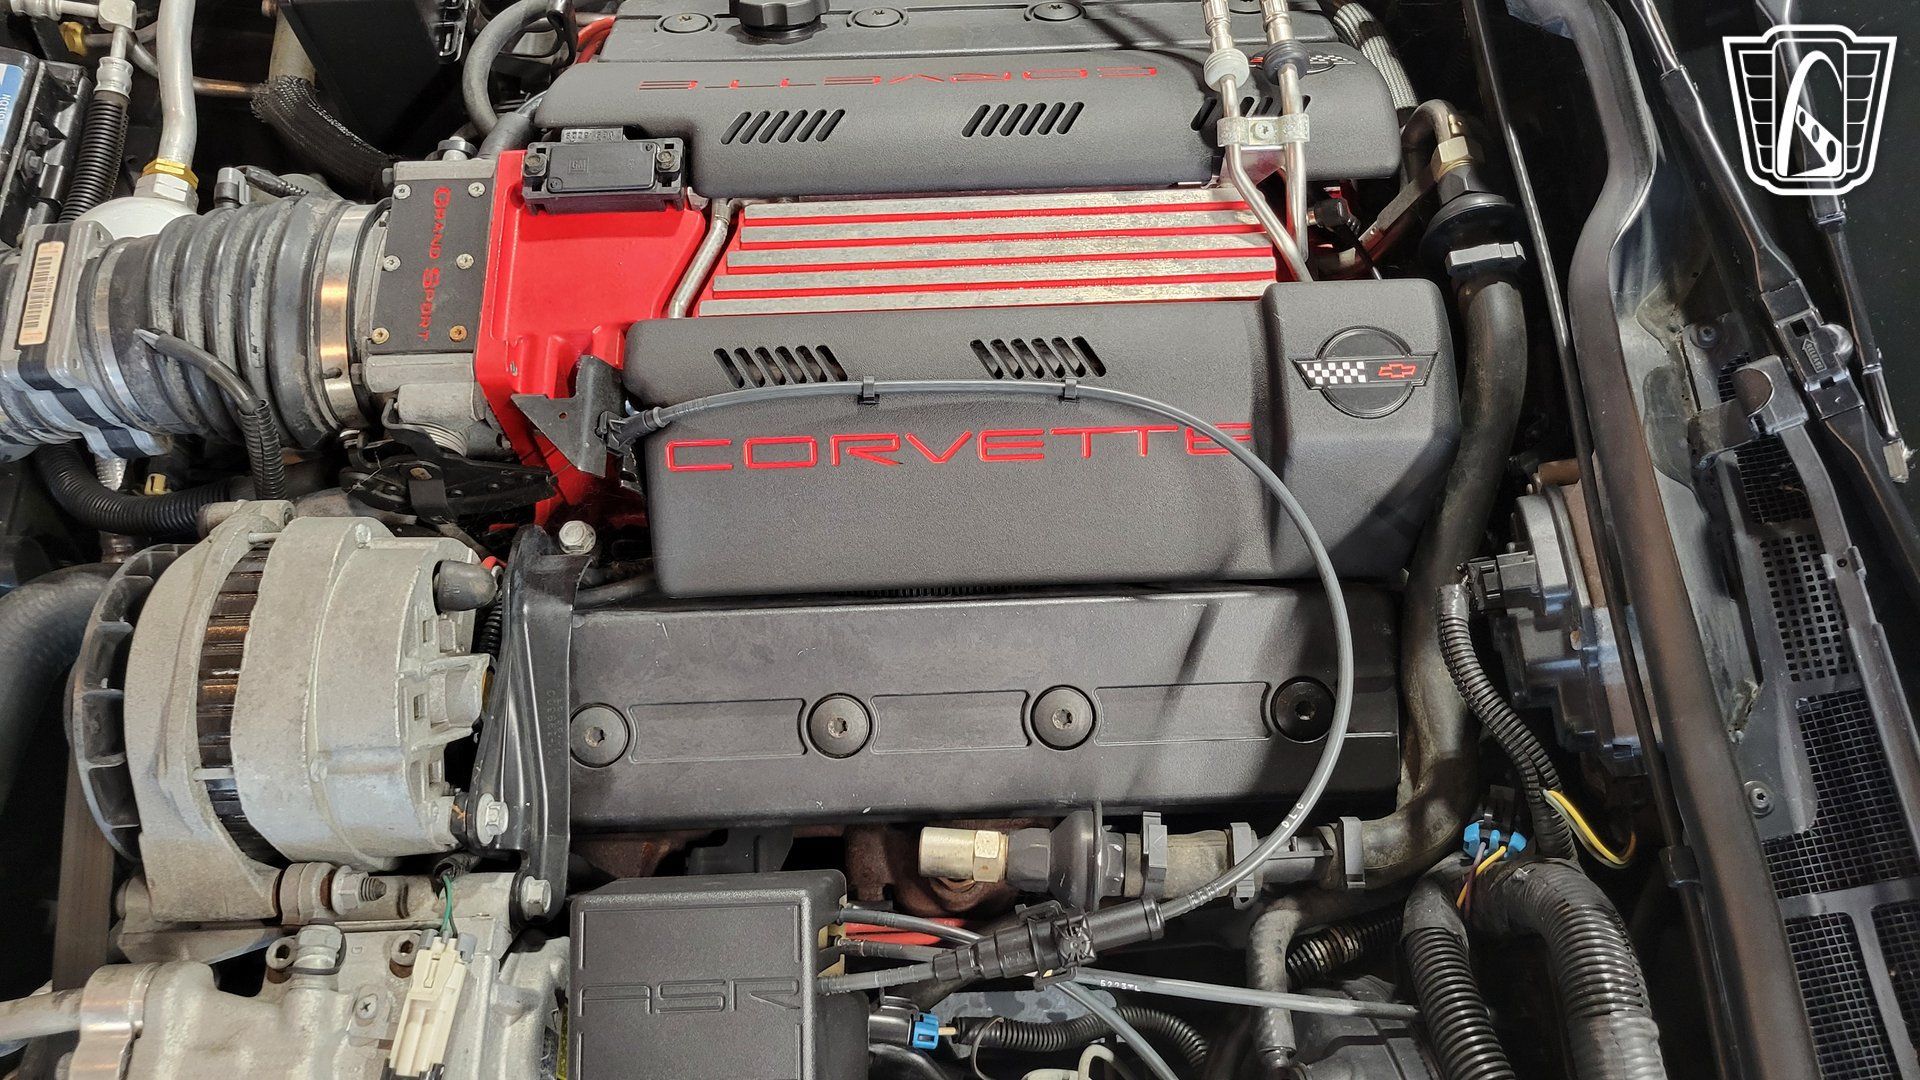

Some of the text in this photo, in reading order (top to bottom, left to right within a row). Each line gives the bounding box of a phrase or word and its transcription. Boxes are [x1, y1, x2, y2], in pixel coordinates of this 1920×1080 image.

[639, 66, 1157, 91] CORVETTE
[417, 186, 452, 342] GRAND SPORT
[664, 422, 1252, 472] CORVETTE
[1281, 802, 1304, 829] DLC
[578, 976, 801, 1017] ASR
